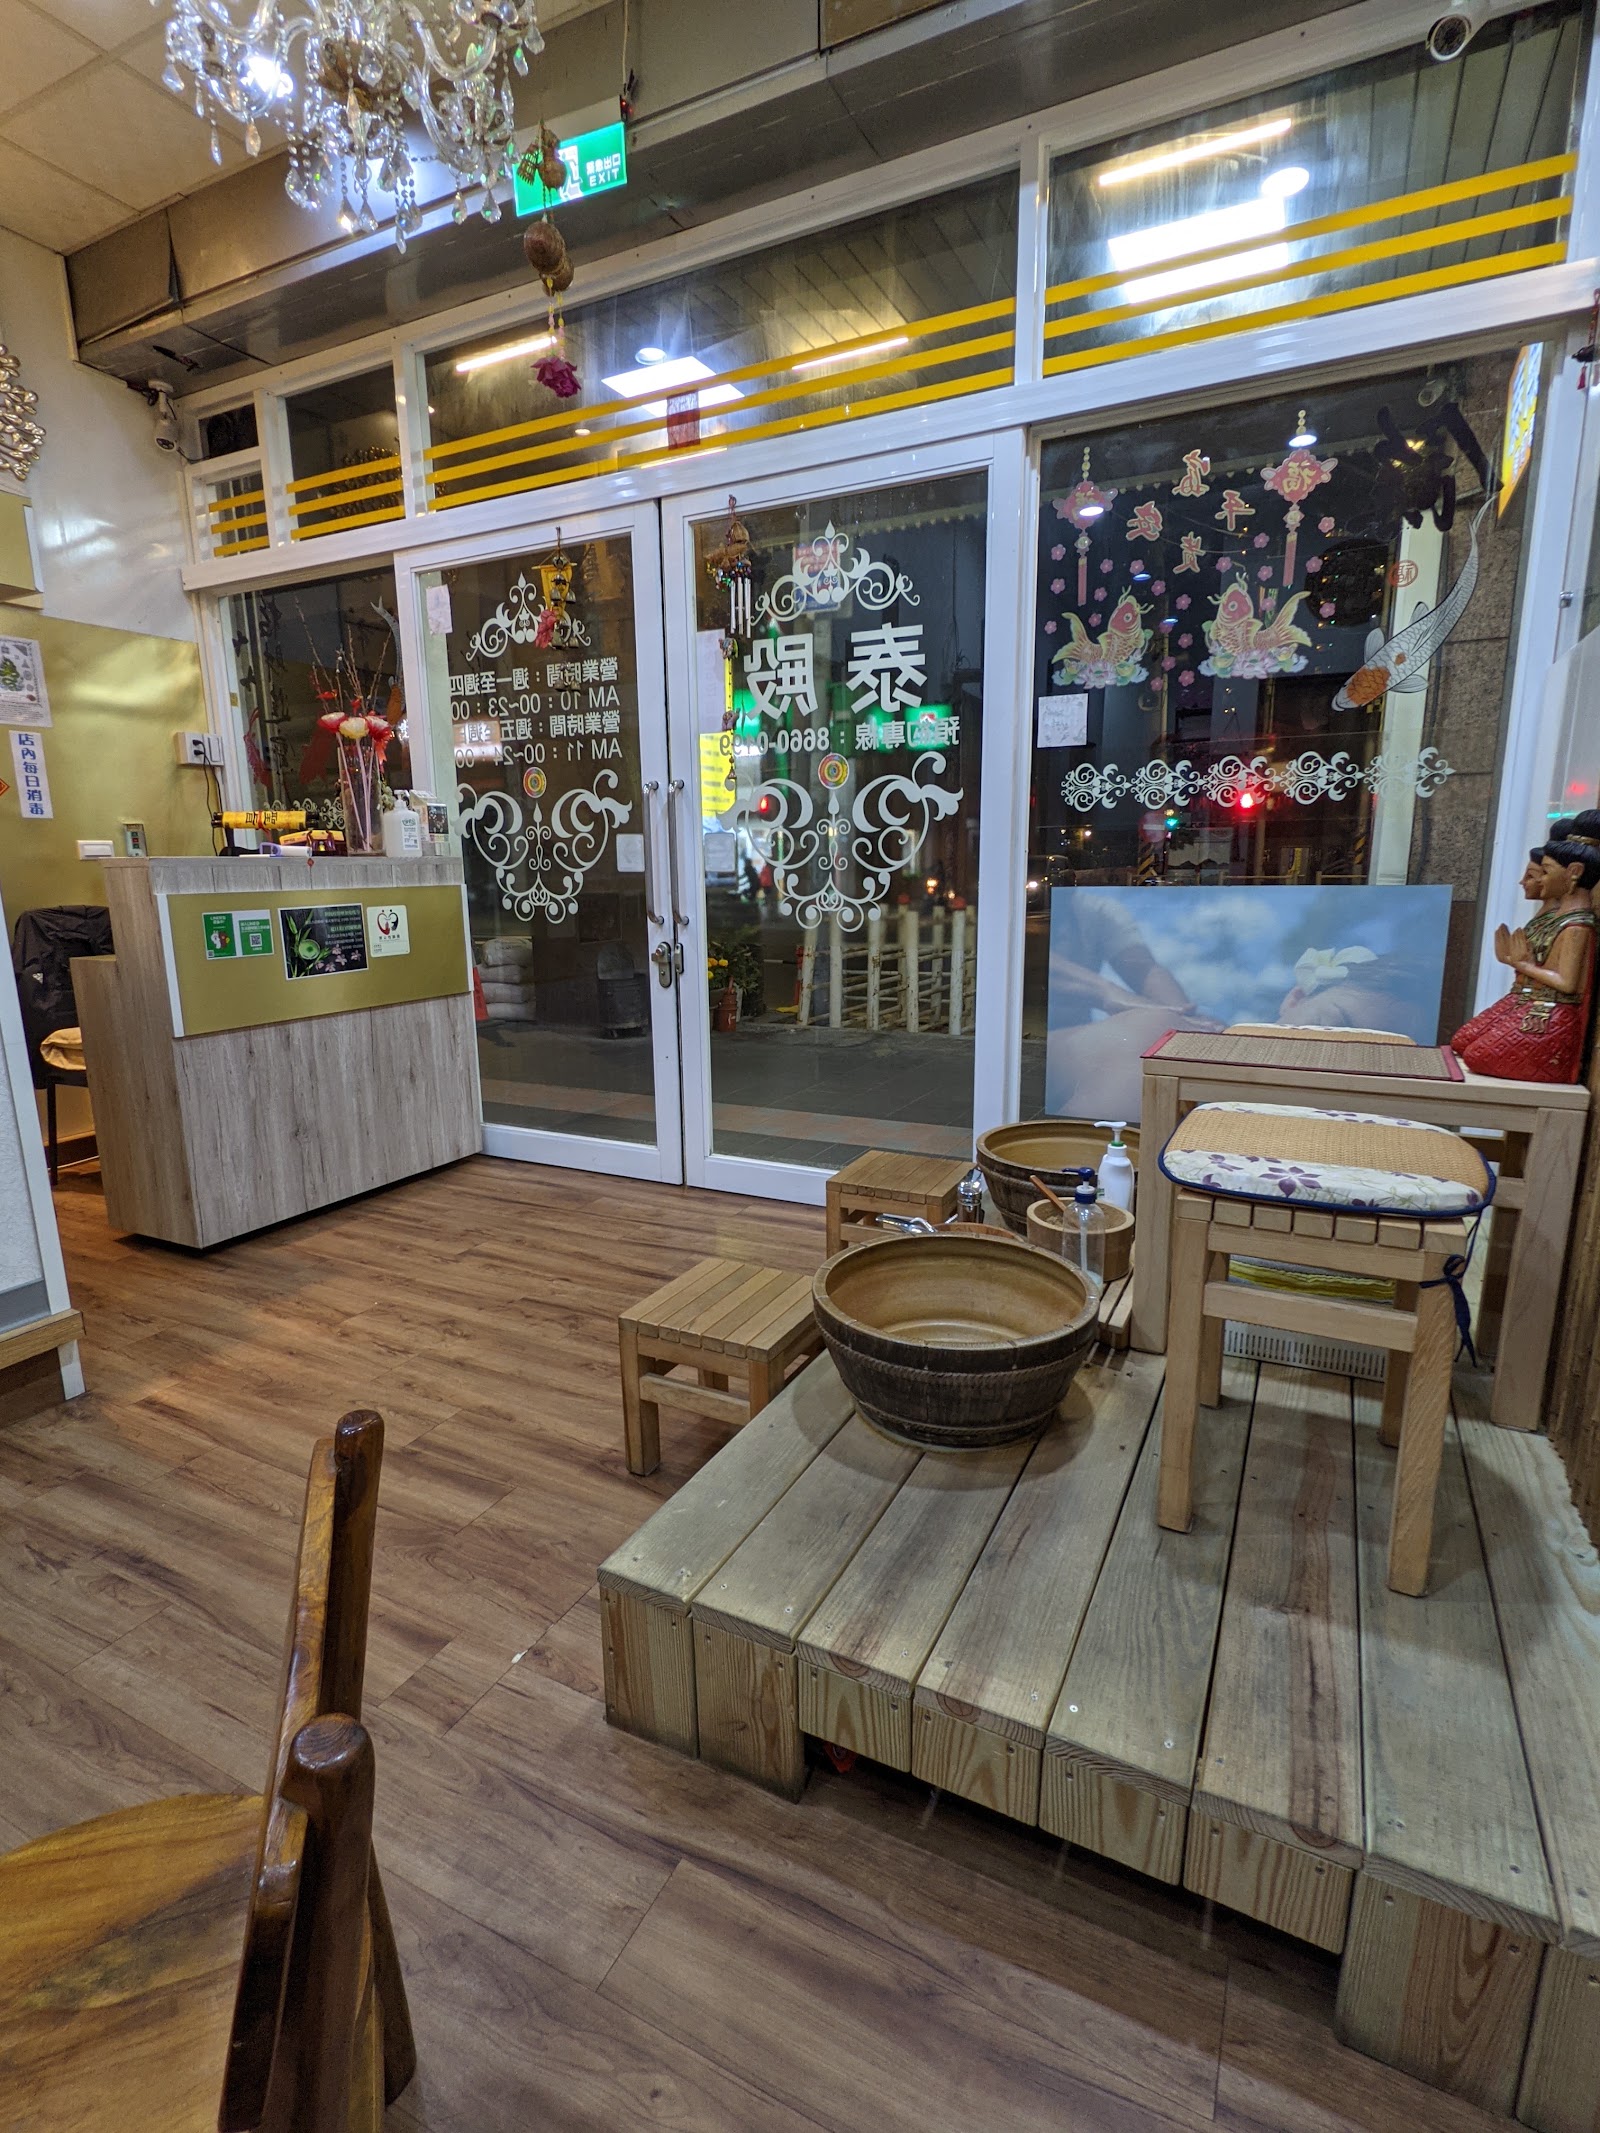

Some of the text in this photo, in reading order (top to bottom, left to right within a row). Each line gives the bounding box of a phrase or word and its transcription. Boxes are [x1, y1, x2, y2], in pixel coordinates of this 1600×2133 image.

[589, 167, 620, 187] EXIT
[18, 733, 45, 815] 店內每日消毒
